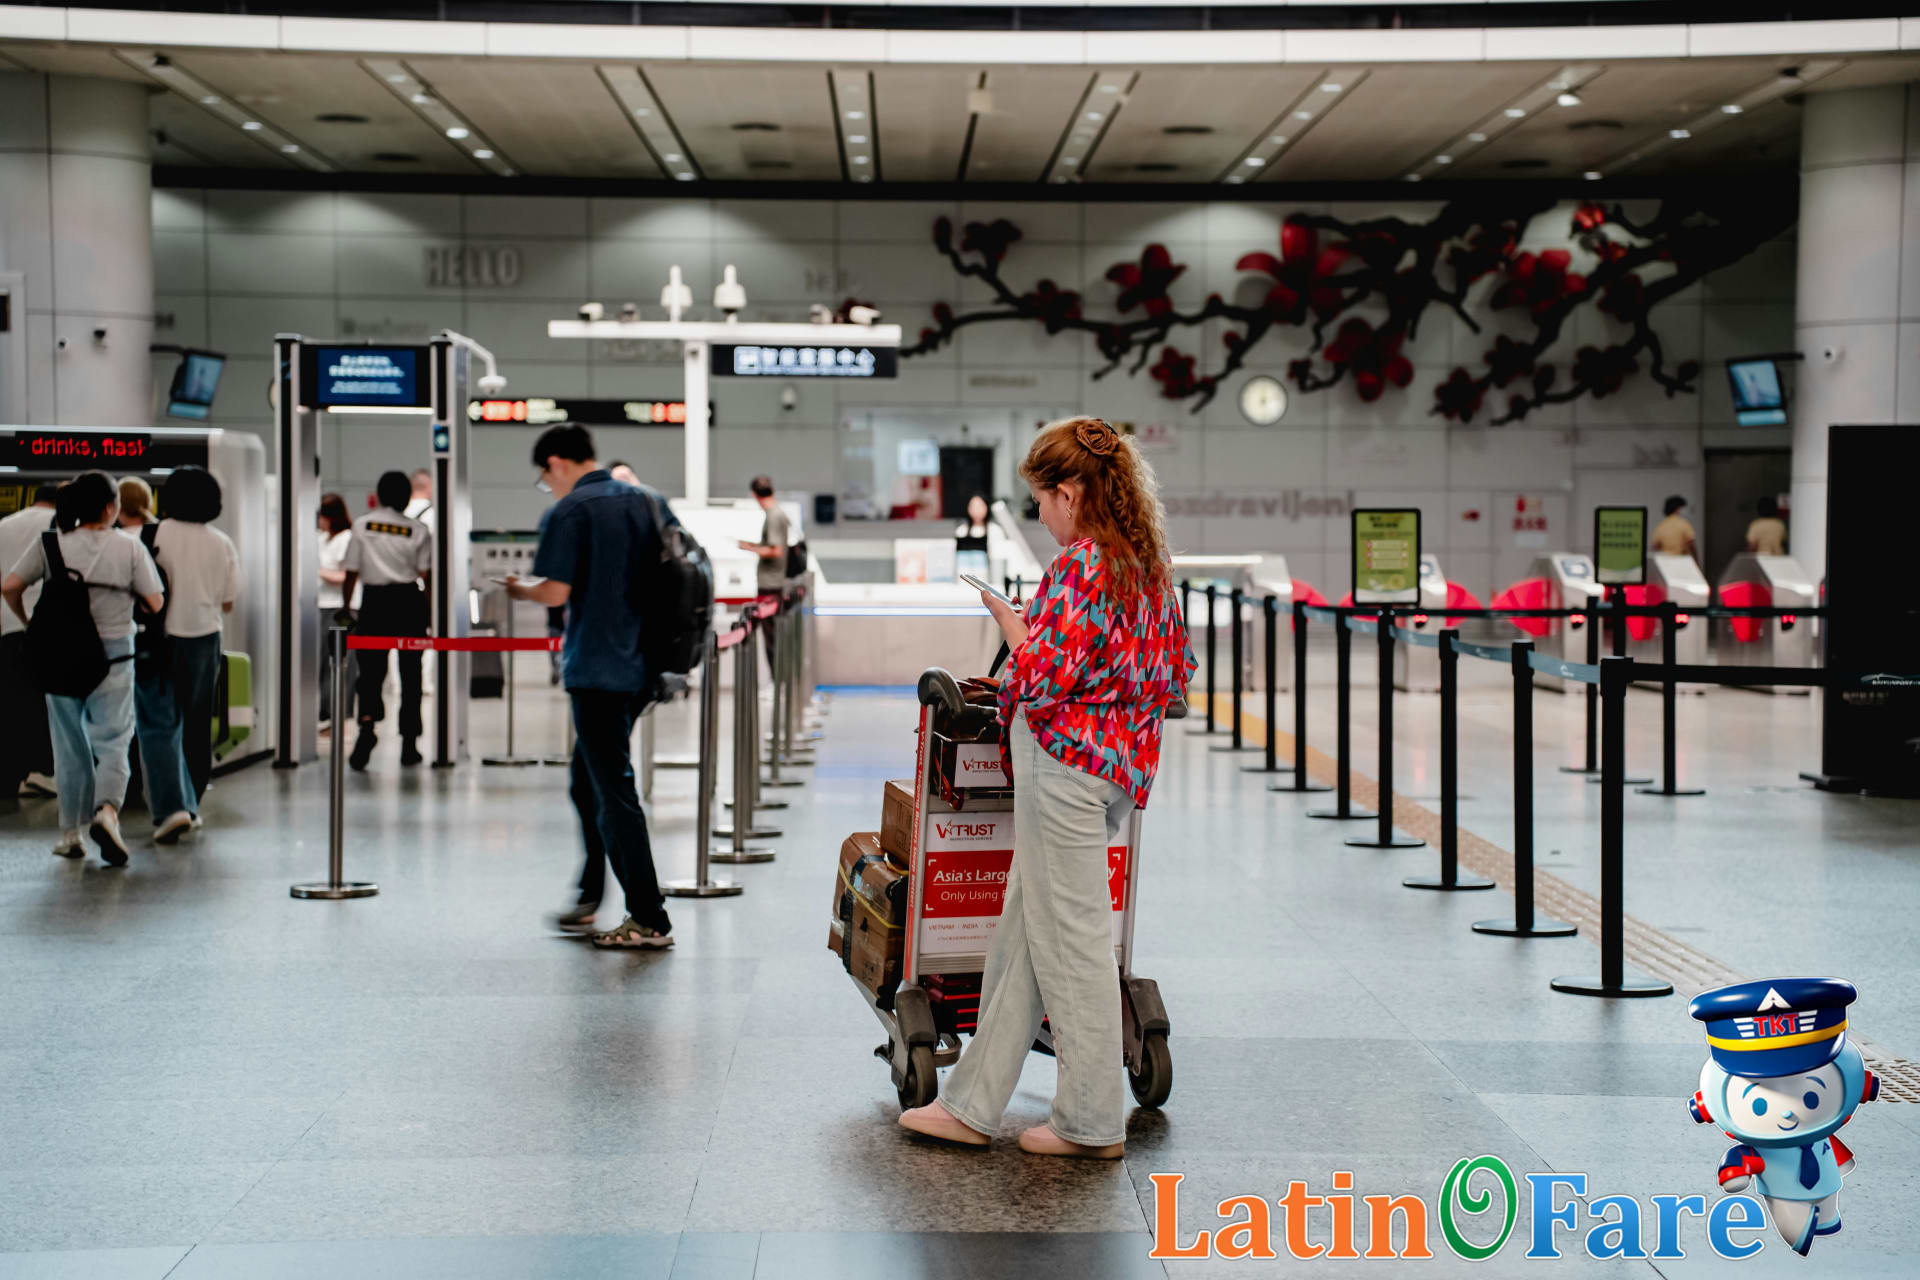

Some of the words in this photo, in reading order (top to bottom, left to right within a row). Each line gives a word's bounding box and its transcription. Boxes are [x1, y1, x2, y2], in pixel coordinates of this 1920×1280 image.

[424, 247, 519, 287] HELLO
[31, 437, 97, 459] drinks,
[933, 869, 972, 882] Asia's
[941, 890, 966, 902] Only
[969, 890, 999, 901] Using
